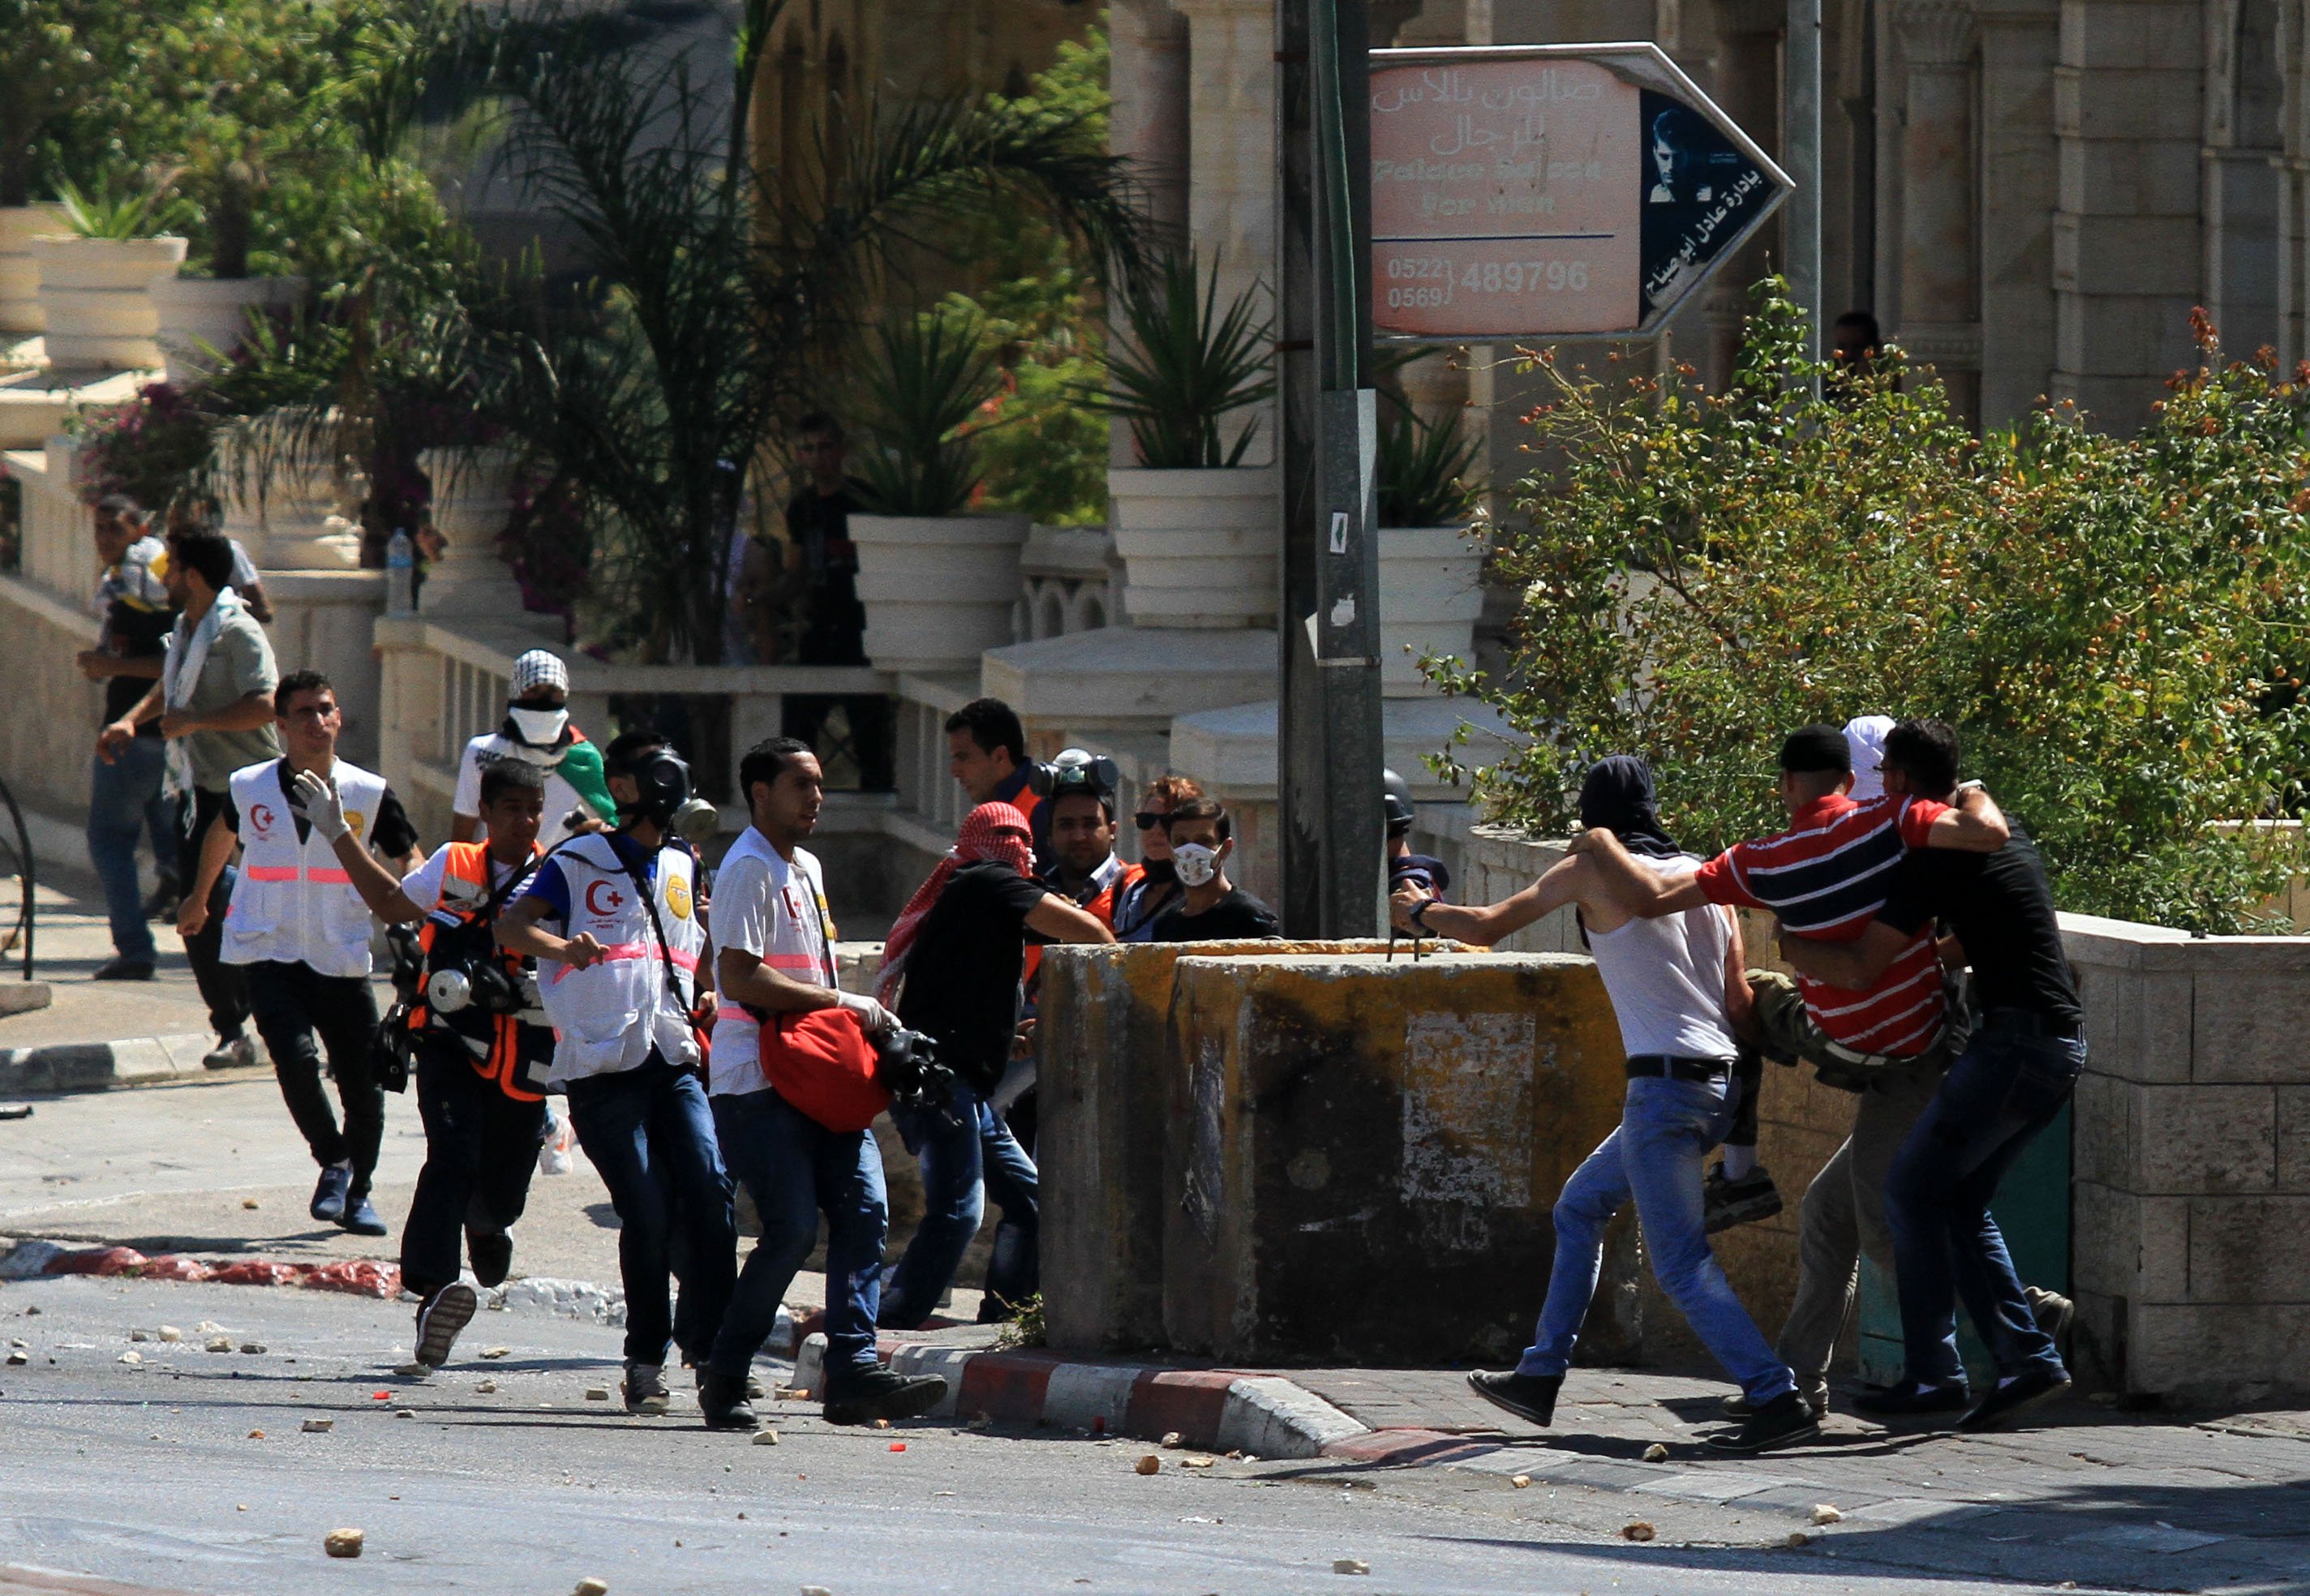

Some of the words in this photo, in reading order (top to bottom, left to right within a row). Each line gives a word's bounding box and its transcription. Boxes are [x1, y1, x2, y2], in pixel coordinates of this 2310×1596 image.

[1480, 69, 1603, 112] صالون
[1430, 114, 1545, 156] للرجال
[1695, 206, 1728, 243] عادل
[1388, 258, 1441, 278] 0522
[1461, 261, 1587, 292] 489796
[1388, 287, 1442, 308] 0569
